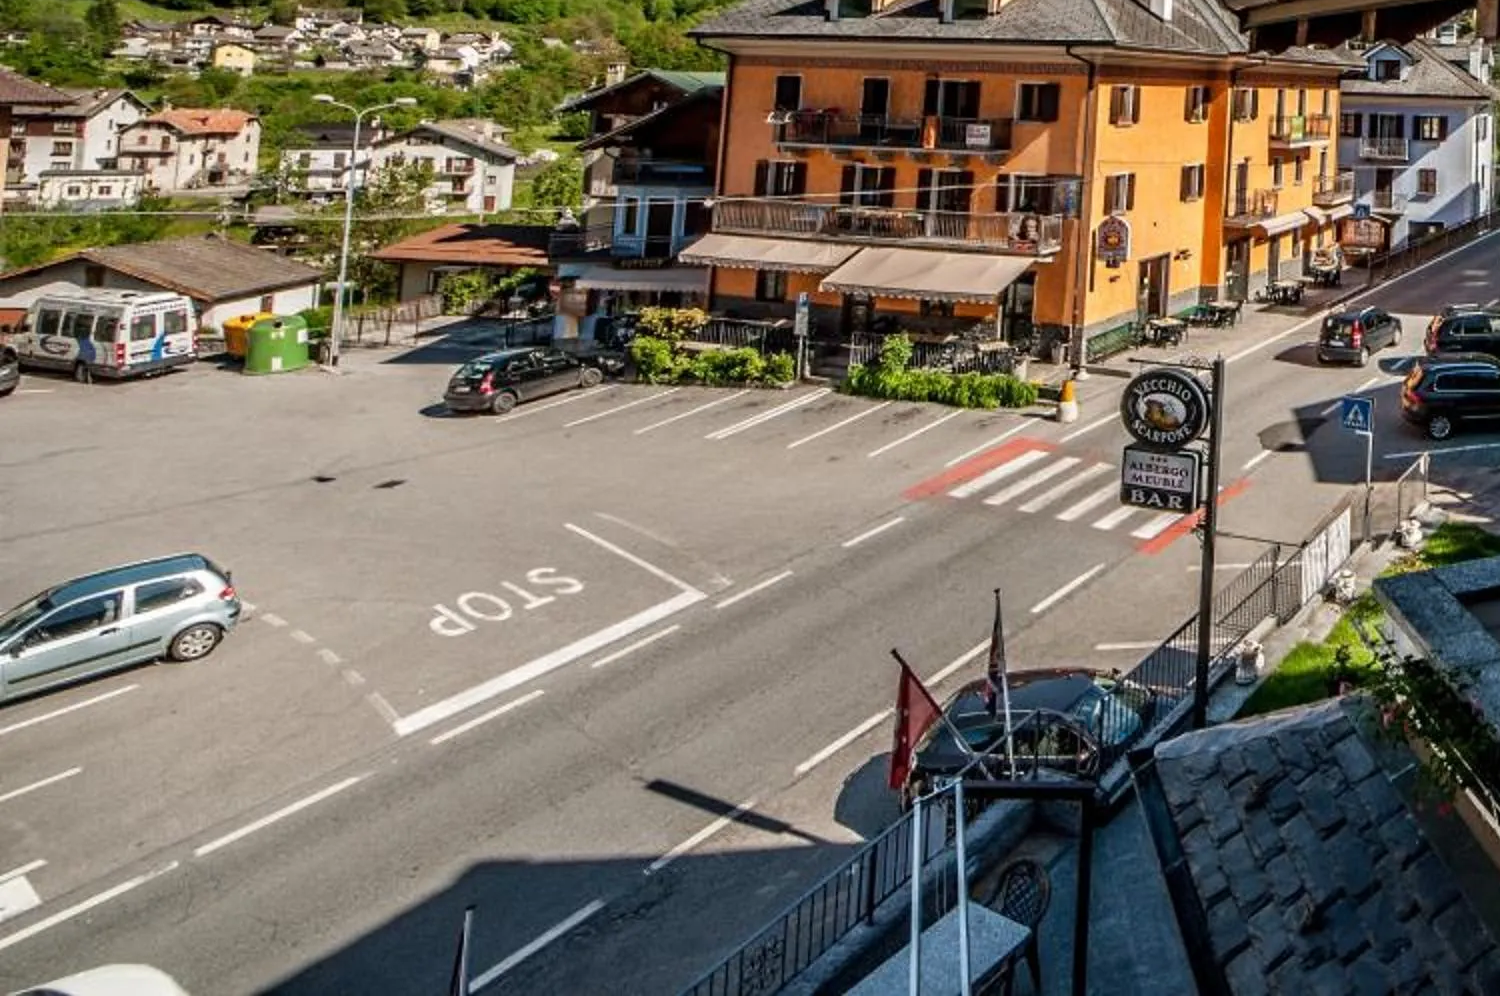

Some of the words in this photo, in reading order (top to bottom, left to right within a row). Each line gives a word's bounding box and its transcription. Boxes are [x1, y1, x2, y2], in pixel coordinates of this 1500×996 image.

[1133, 380, 1192, 401] VECCHIO
[1131, 419, 1192, 443] SCARPONE
[1129, 461, 1189, 477] ALBERGO
[1131, 489, 1184, 509] BAR
[429, 567, 584, 637] STOP
